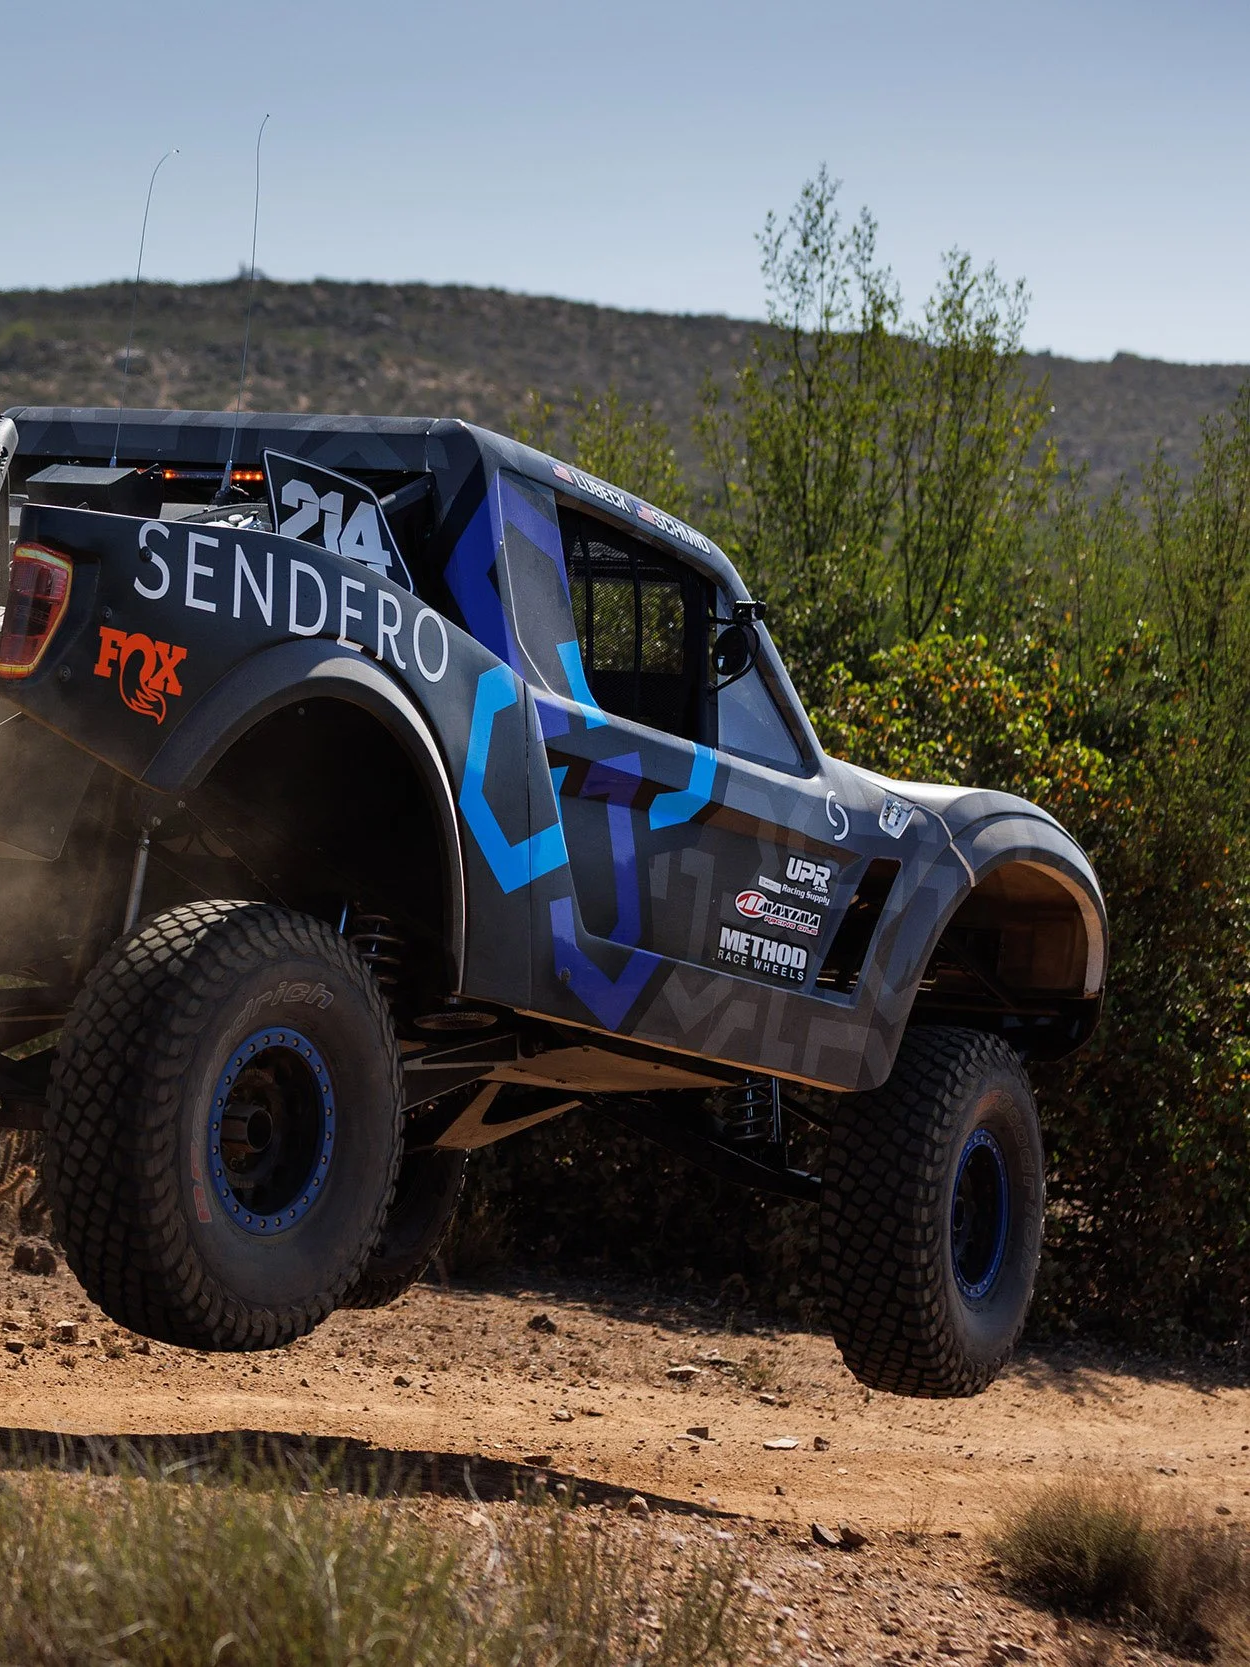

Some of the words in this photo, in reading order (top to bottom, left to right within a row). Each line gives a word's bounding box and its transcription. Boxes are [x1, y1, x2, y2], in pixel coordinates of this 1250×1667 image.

[571, 471, 632, 513] LUBECK
[280, 478, 392, 578] 214
[650, 510, 711, 555] SCHMID
[134, 520, 449, 683] SENDERO
[93, 625, 187, 724] FOX
[785, 856, 831, 888] UPR
[758, 899, 821, 929] MAXIMA
[781, 883, 805, 899] Racing
[805, 890, 830, 907] Supply
[763, 915, 797, 930] RACING
[717, 949, 748, 966] RACE
[753, 958, 805, 981] WHEELS
[719, 926, 808, 970] METHOD
